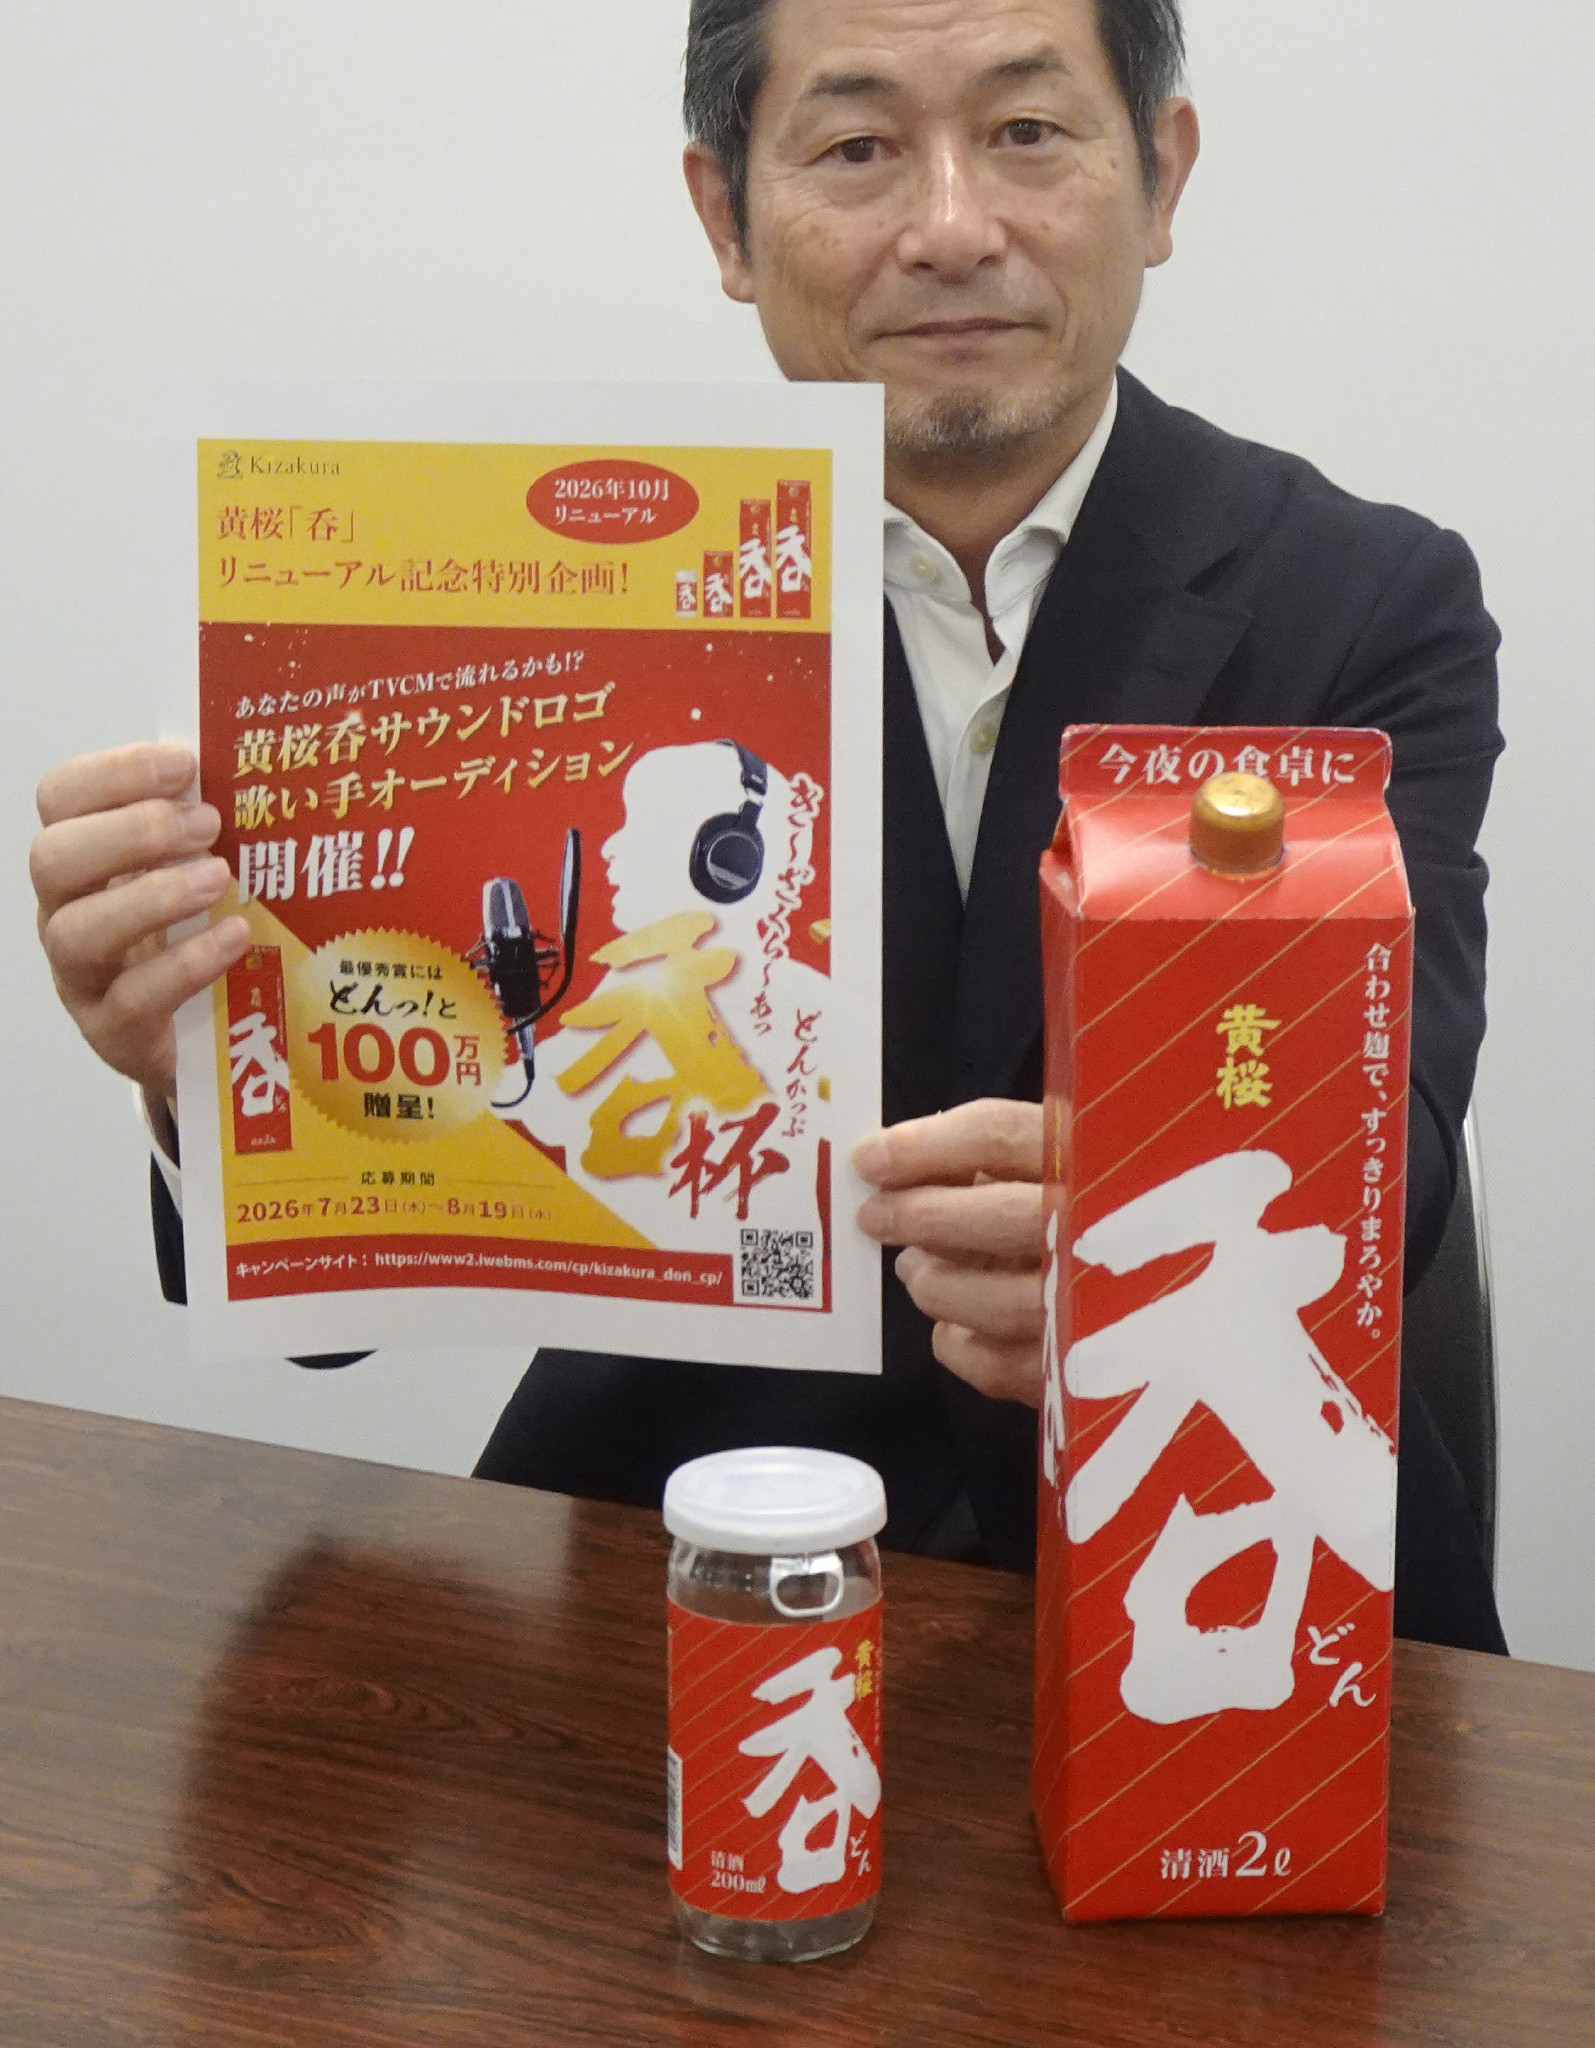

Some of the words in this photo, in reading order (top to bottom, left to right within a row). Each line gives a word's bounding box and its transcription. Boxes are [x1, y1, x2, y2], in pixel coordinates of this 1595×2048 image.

[250, 456, 340, 476] Kizakura
[554, 477, 670, 500] 2026年10月
[217, 504, 355, 543] 黄桜「呑」
[555, 505, 658, 526] リニューアル
[219, 555, 629, 596] リニューアル記念特別企画!
[235, 650, 585, 719] あなたの声がTVCMで流れるかも!?
[233, 681, 617, 779] 黄桜呑サウンドロゴ
[234, 741, 634, 829] 歌い手オーディション
[1099, 742, 1356, 787] 今夜の食卓に
[238, 825, 415, 904] 開催!!
[339, 958, 443, 981] 最優秀賞には
[329, 980, 457, 1018] どんっ!と
[782, 1008, 823, 1138] どんかっぷ
[1215, 1003, 1282, 1110] 黄桜
[363, 1091, 435, 1120] 贈呈!
[361, 1170, 435, 1186] 応募期間
[1306, 1622, 1377, 1708] どん
